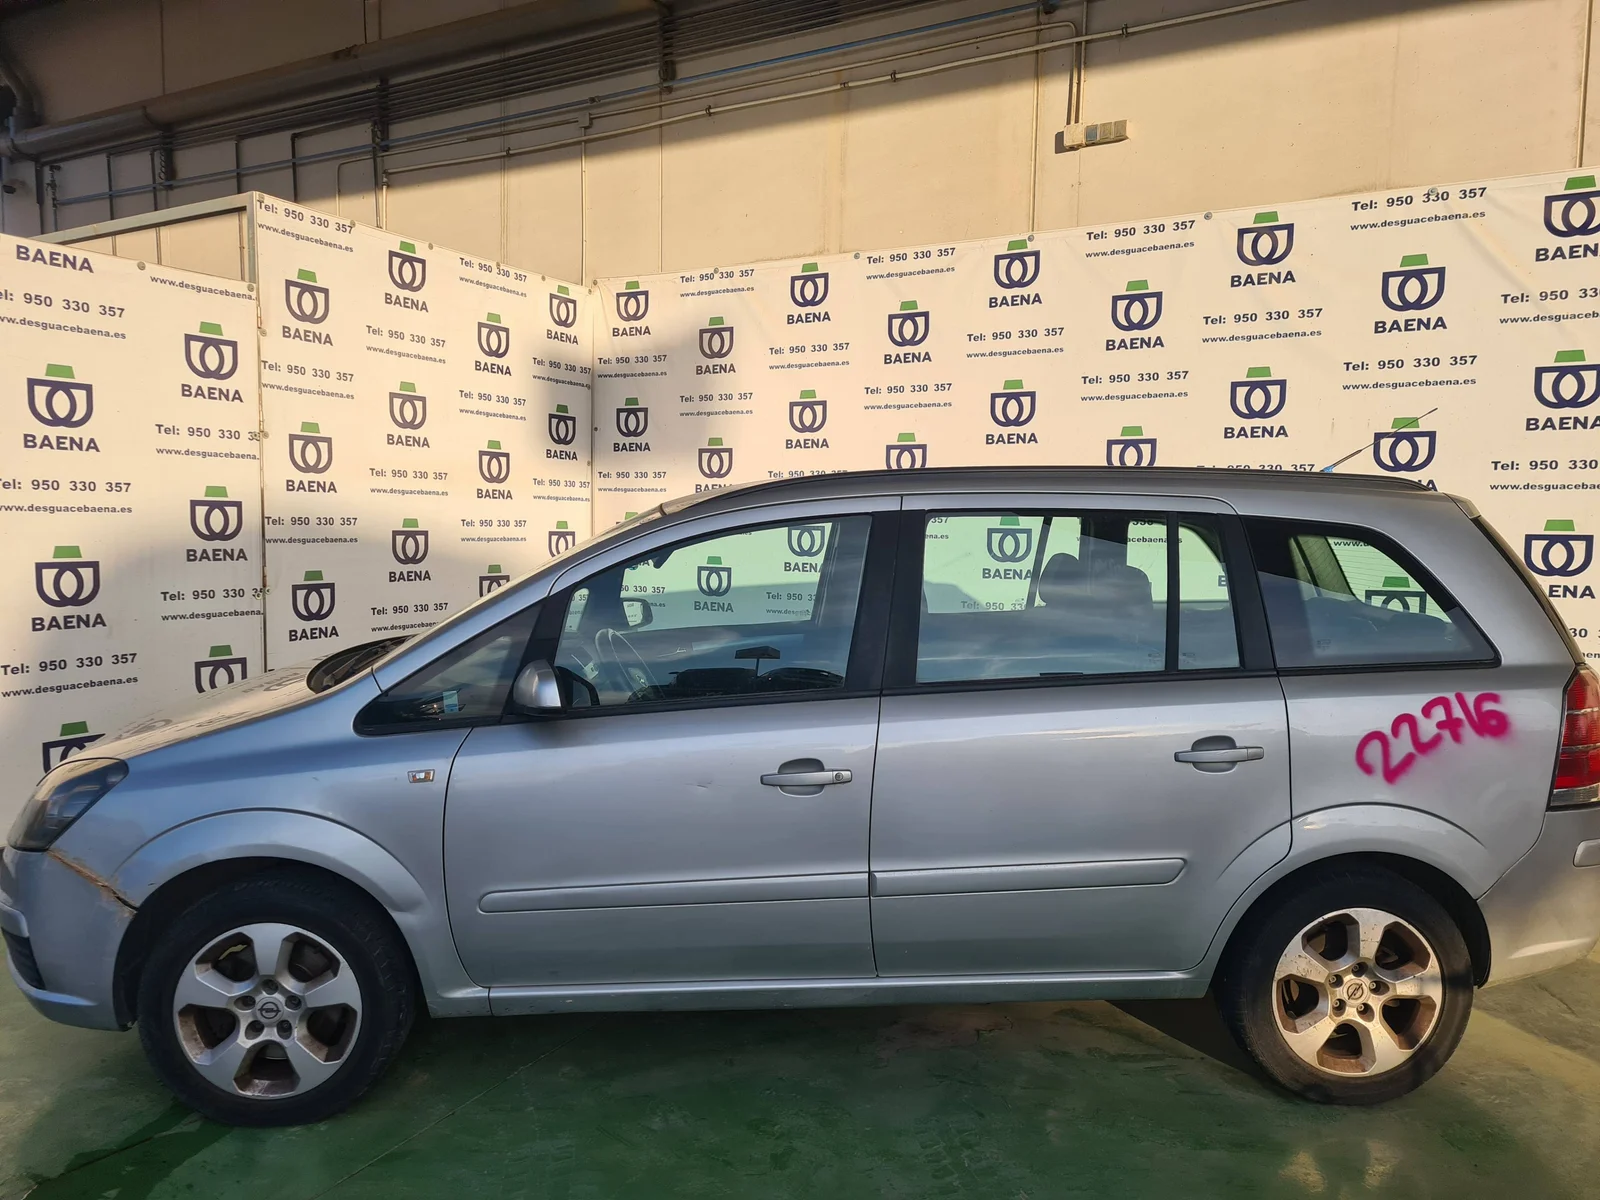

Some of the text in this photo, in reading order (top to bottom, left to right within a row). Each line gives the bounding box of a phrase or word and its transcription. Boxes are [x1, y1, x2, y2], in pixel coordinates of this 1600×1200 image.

[1351, 187, 1487, 212] Tel: 950 330 357
[257, 199, 354, 234] Tel: 950 330 357
[1350, 210, 1485, 231] www.desguacebaena.es
[257, 222, 354, 253] www.desguacebaena.es
[1086, 220, 1196, 241] Tel: 950 330 357
[867, 247, 956, 265] Tel: 950 330 357
[1085, 240, 1194, 258] www.desguacebaena.es
[1535, 243, 1599, 262] BAEN
[16, 244, 94, 273] BAENA
[459, 275, 527, 298] www.desguacebaena.es
[1230, 270, 1296, 288] BAENA
[150, 275, 256, 301] www.desguacebaena.
[679, 285, 755, 298] www.desguacebaena.es
[385, 292, 428, 313] BAENA
[988, 293, 1042, 308] BAENA
[1501, 290, 1568, 304] Tel: 950
[23, 292, 125, 318] 950 330 357
[787, 311, 831, 325] BAENA
[1203, 307, 1323, 326] Tel: 950 330 357
[612, 326, 651, 337] BAENA
[1374, 316, 1447, 334] BAENA
[282, 325, 333, 346] BAENA
[366, 325, 446, 348] Tel: 950 330 357
[546, 329, 579, 345] BAENA
[967, 327, 1065, 342] Tel: 950 330 357
[1202, 329, 1322, 344] www.desguacebaena.es
[1105, 336, 1165, 351] BAENA
[366, 344, 446, 364] www.desguacebaena.es
[884, 351, 932, 365] BAENA
[474, 360, 512, 376] BAENA
[695, 363, 736, 375] BAENA
[1343, 355, 1478, 371] Tel: 950 330 357
[261, 360, 354, 383] Tel: 950 330 357
[1081, 370, 1189, 385] Tel: 950 330 357
[261, 381, 354, 400] www.desguacebaena.es
[864, 383, 952, 395] Tel: 950 330 357
[1342, 377, 1476, 391] www.desguacebaena.es
[181, 383, 243, 403] BAENA
[459, 389, 526, 407] Tel: 950 330 357
[679, 392, 753, 403] Tel: 950 330 357
[1080, 391, 1188, 401] www.desguacebaena.es
[679, 409, 753, 418] www.desguacebaena.es
[864, 401, 952, 411] www.desguacebaena.es
[1525, 416, 1600, 431] BAENA
[155, 424, 180, 436] Tel:
[188, 427, 210, 438] 950
[219, 429, 240, 441] 330
[985, 433, 1038, 445] BAENA
[1223, 426, 1288, 439] BAENA
[23, 433, 100, 452] BAENA
[387, 434, 430, 448] BAENA
[613, 442, 651, 452] BAENA
[785, 438, 829, 450] BAENA
[156, 447, 259, 461] www.desguacebaena.
[546, 449, 578, 461] BAENA
[1491, 459, 1598, 470] Tel: 950 330
[369, 468, 448, 481] Tel: 950 330 357
[598, 471, 667, 479] Tel: 950 330 357
[0, 478, 131, 492] el: 950 330 357
[286, 479, 337, 493] BAENA
[597, 486, 667, 494] www.desguacebaena.es
[476, 488, 513, 500] BAENA
[265, 516, 358, 526] Tel: 950 330 357
[461, 519, 527, 528] Tel: 950 330 357
[186, 548, 248, 562] BAENA
[388, 570, 431, 582] BAENA
[982, 568, 1032, 580] BAENA
[161, 591, 185, 602] Tel:
[192, 589, 216, 600] 950
[223, 588, 245, 599] 330
[633, 585, 665, 594] 330 357
[693, 601, 734, 613] BAENA
[961, 601, 1004, 611] Tel: 950
[31, 613, 107, 632] BAENA
[161, 609, 264, 621] www.desguacebaena.
[289, 626, 339, 642] BAENA
[1, 652, 138, 676] Tel: 950 330 357
[1, 675, 138, 698] www.desguacebaena.es
